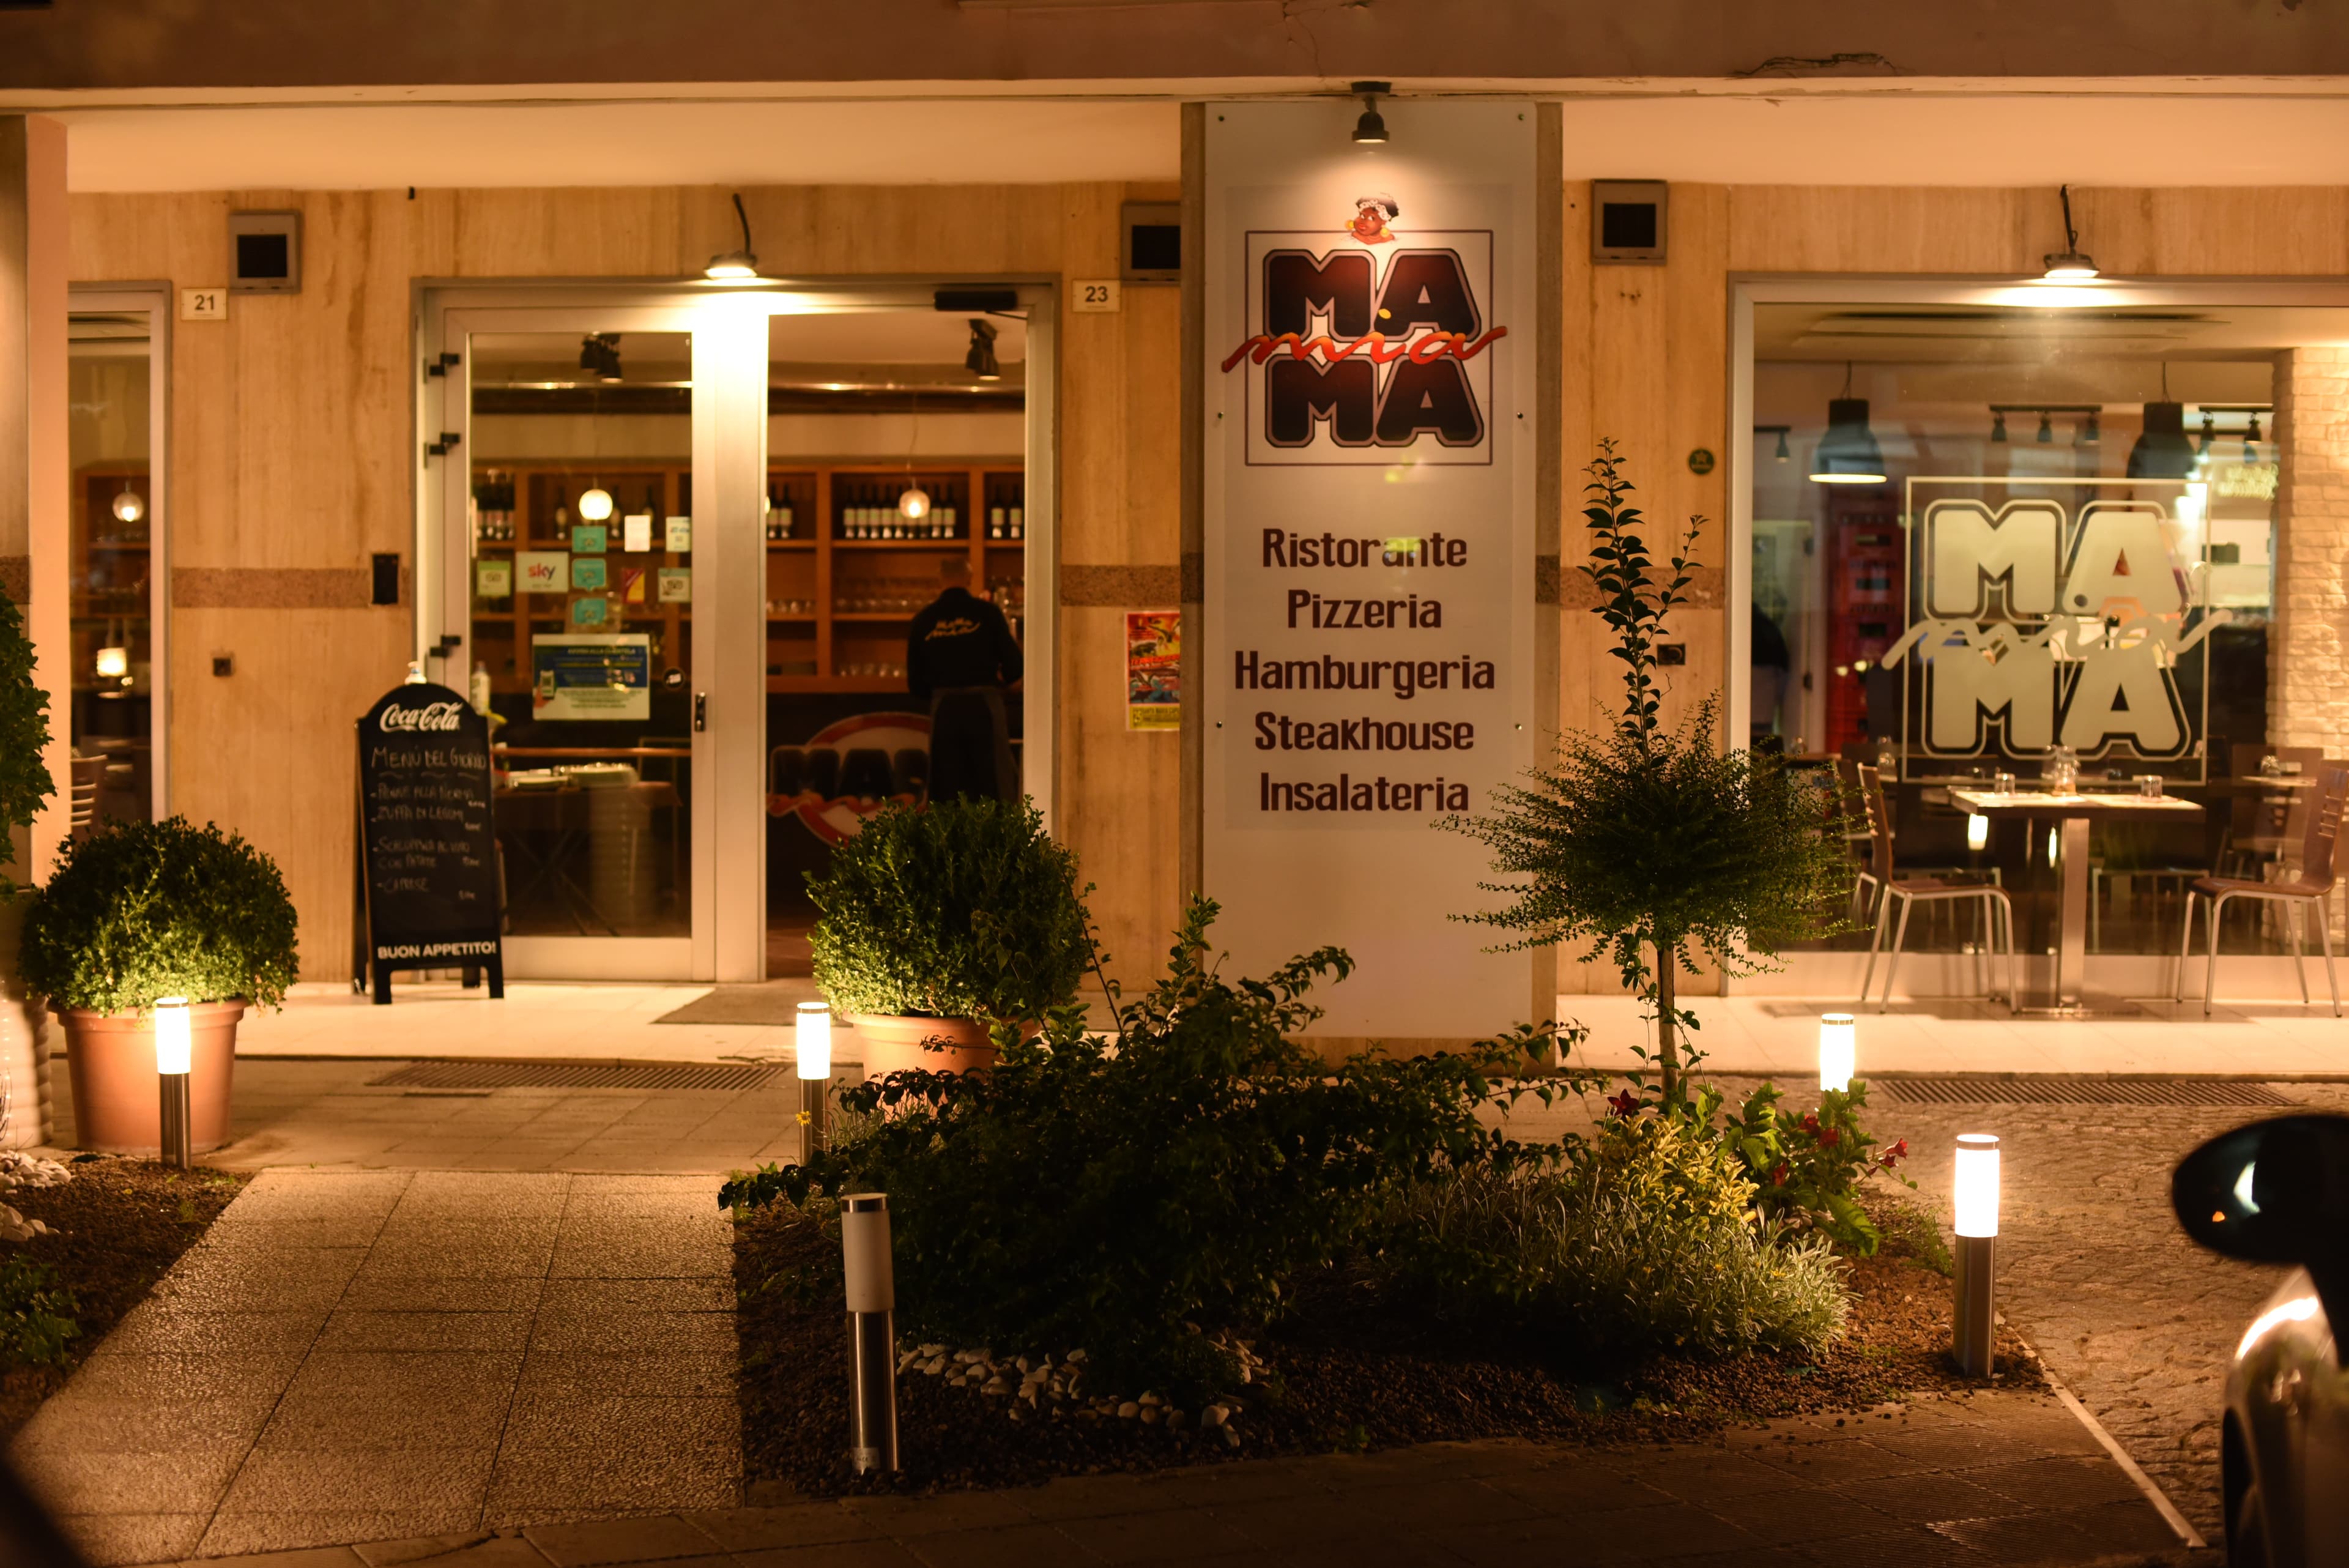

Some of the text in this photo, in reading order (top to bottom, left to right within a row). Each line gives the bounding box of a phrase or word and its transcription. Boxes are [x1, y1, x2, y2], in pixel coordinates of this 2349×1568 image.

[194, 294, 214, 311] 21
[1085, 286, 1108, 302] 23
[1263, 248, 1481, 343] MA
[1222, 326, 1507, 373] mia
[1265, 354, 1484, 448] MA
[1263, 528, 1468, 567] Ristorante
[1924, 499, 2191, 624] MA
[528, 562, 556, 581] sky
[1288, 589, 1442, 628] Pizzeria
[1235, 650, 1495, 700] Hamburgeria
[379, 702, 463, 732] Coca-Cola
[1921, 635, 2191, 762] MA
[1255, 712, 1474, 751] Steakhouse
[1261, 772, 1469, 811] Insalateria
[377, 941, 497, 960] BUON APPETITO!
